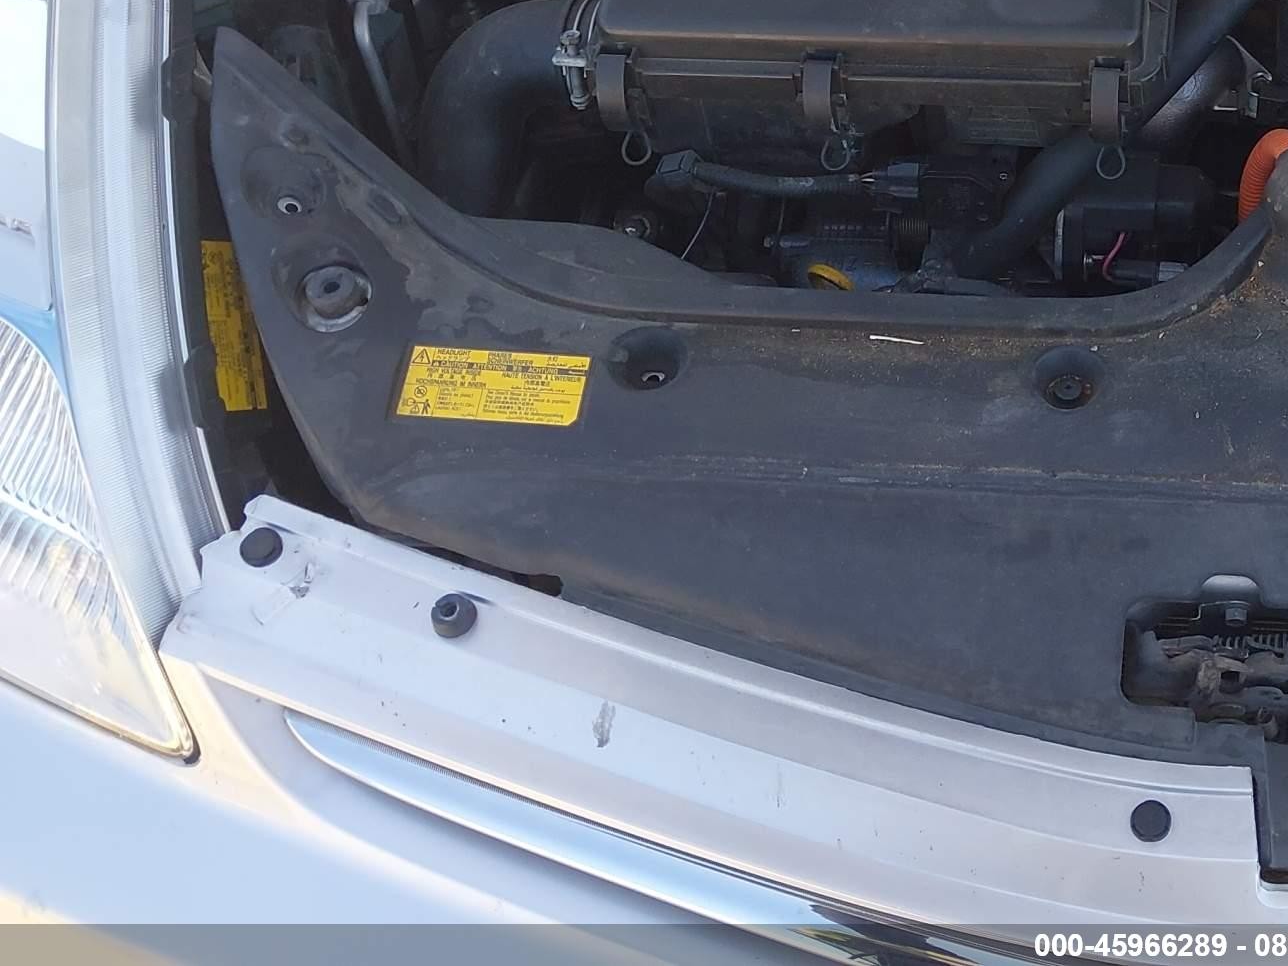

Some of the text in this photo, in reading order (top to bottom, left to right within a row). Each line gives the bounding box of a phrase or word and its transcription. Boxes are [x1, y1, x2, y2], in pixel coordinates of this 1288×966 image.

[437, 349, 471, 357] HEADLIGHT
[440, 361, 468, 369] CAUTION
[472, 362, 507, 371] ATTENTION
[528, 367, 559, 375] ACHTUNG
